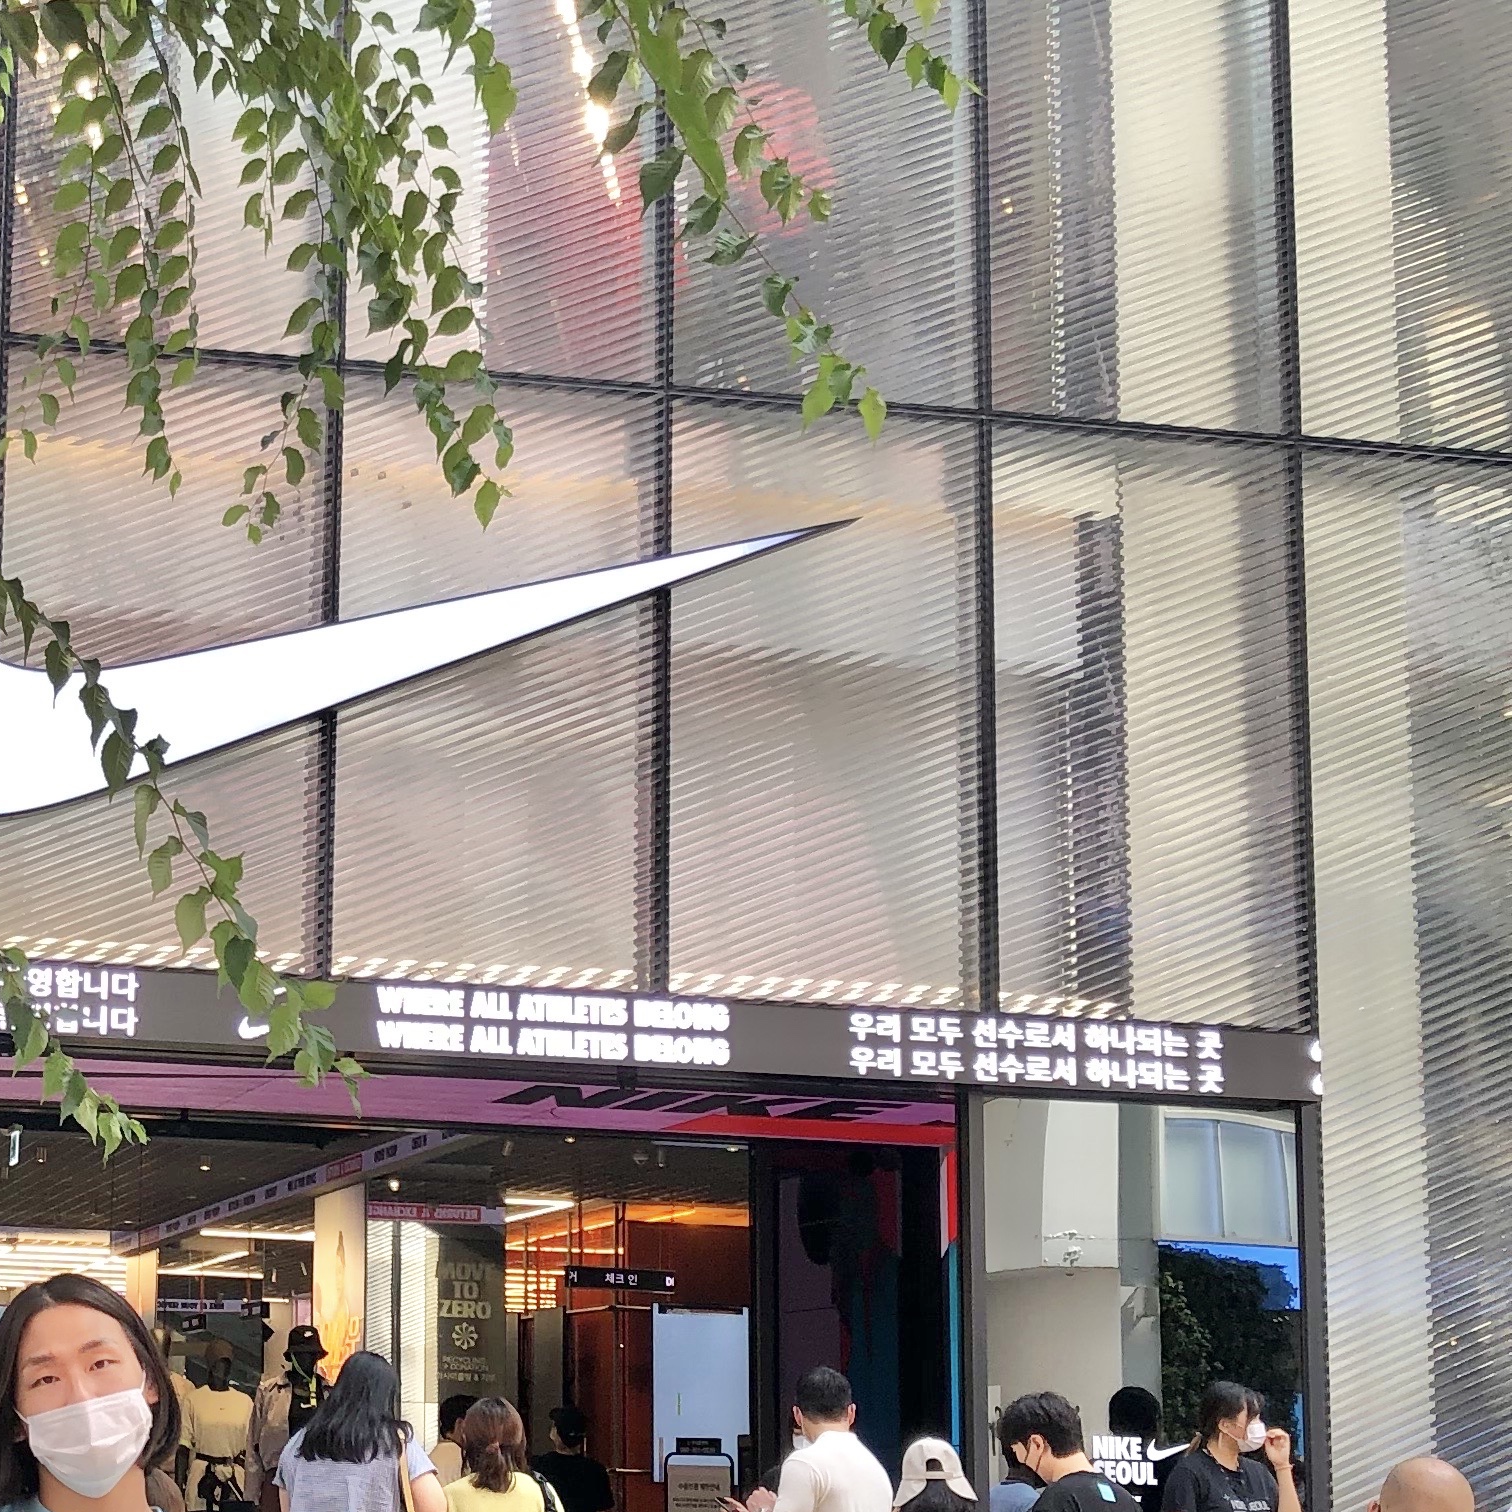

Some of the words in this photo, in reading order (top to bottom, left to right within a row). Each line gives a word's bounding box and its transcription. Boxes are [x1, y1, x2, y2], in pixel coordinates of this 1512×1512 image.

[376, 986, 465, 1018] WHERE
[469, 991, 514, 1020] ALL
[516, 993, 629, 1026] ATHLETES
[633, 999, 730, 1032] BELONG
[376, 1020, 465, 1052] WHERE
[469, 1025, 514, 1055] ALL
[516, 1027, 629, 1061] ATHLETES
[633, 1033, 730, 1066] BELONG
[848, 1013, 901, 1043] 우리
[909, 1016, 964, 1046] 모두
[971, 1018, 1076, 1053] 선수로서
[1083, 1024, 1190, 1057] 하나되는
[1196, 1031, 1223, 1060] 곳
[849, 1046, 902, 1077] 우리
[910, 1050, 965, 1080] 모두
[972, 1052, 1077, 1086] 선수로서
[1085, 1057, 1191, 1091] 하나되는
[1197, 1064, 1225, 1093] 곳
[491, 1084, 912, 1122] NIKE
[439, 1299, 492, 1319] ZERO
[453, 1281, 479, 1299] TO
[1092, 1435, 1143, 1460] NIKE
[1093, 1460, 1159, 1486] SEOUL
